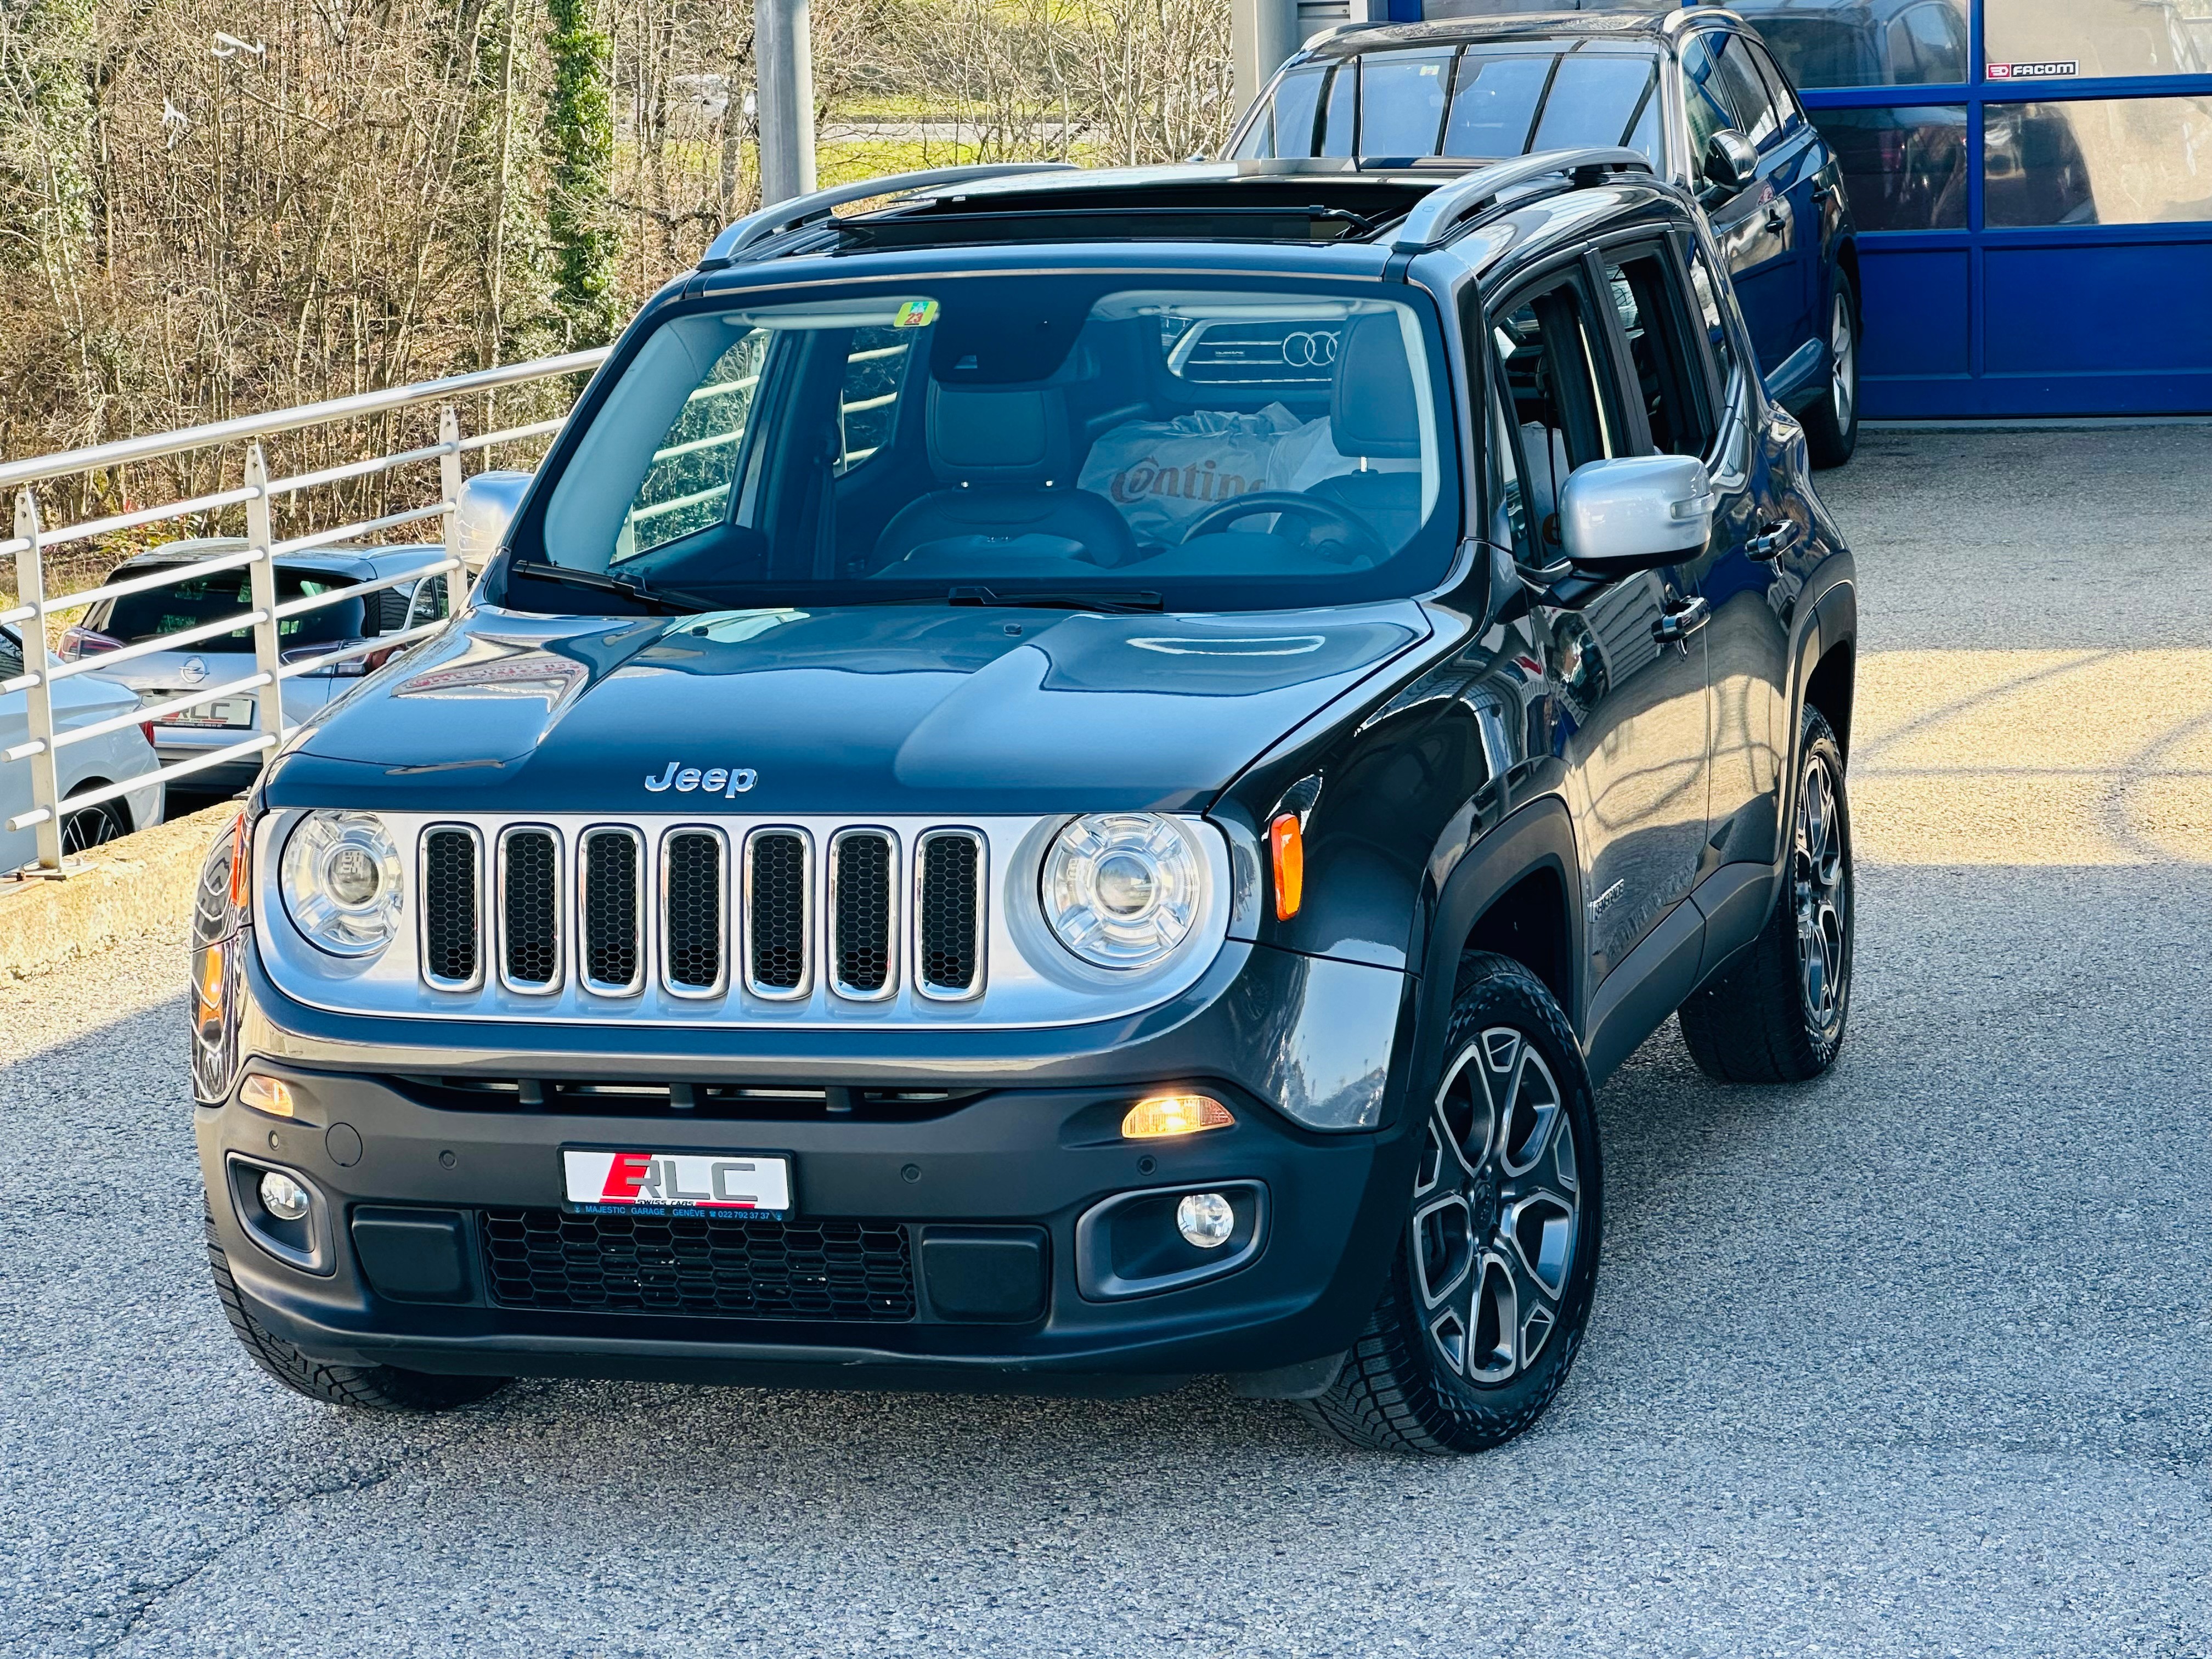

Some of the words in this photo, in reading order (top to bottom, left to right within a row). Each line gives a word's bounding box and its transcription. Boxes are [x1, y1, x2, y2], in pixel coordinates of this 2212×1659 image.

[2013, 63, 2074, 76] FACOM
[904, 312, 924, 324] 23
[644, 761, 758, 798] Jeep
[585, 1205, 626, 1214] MAJESTIC
[631, 1207, 665, 1216] GARAGE
[734, 1211, 748, 1219] 792
